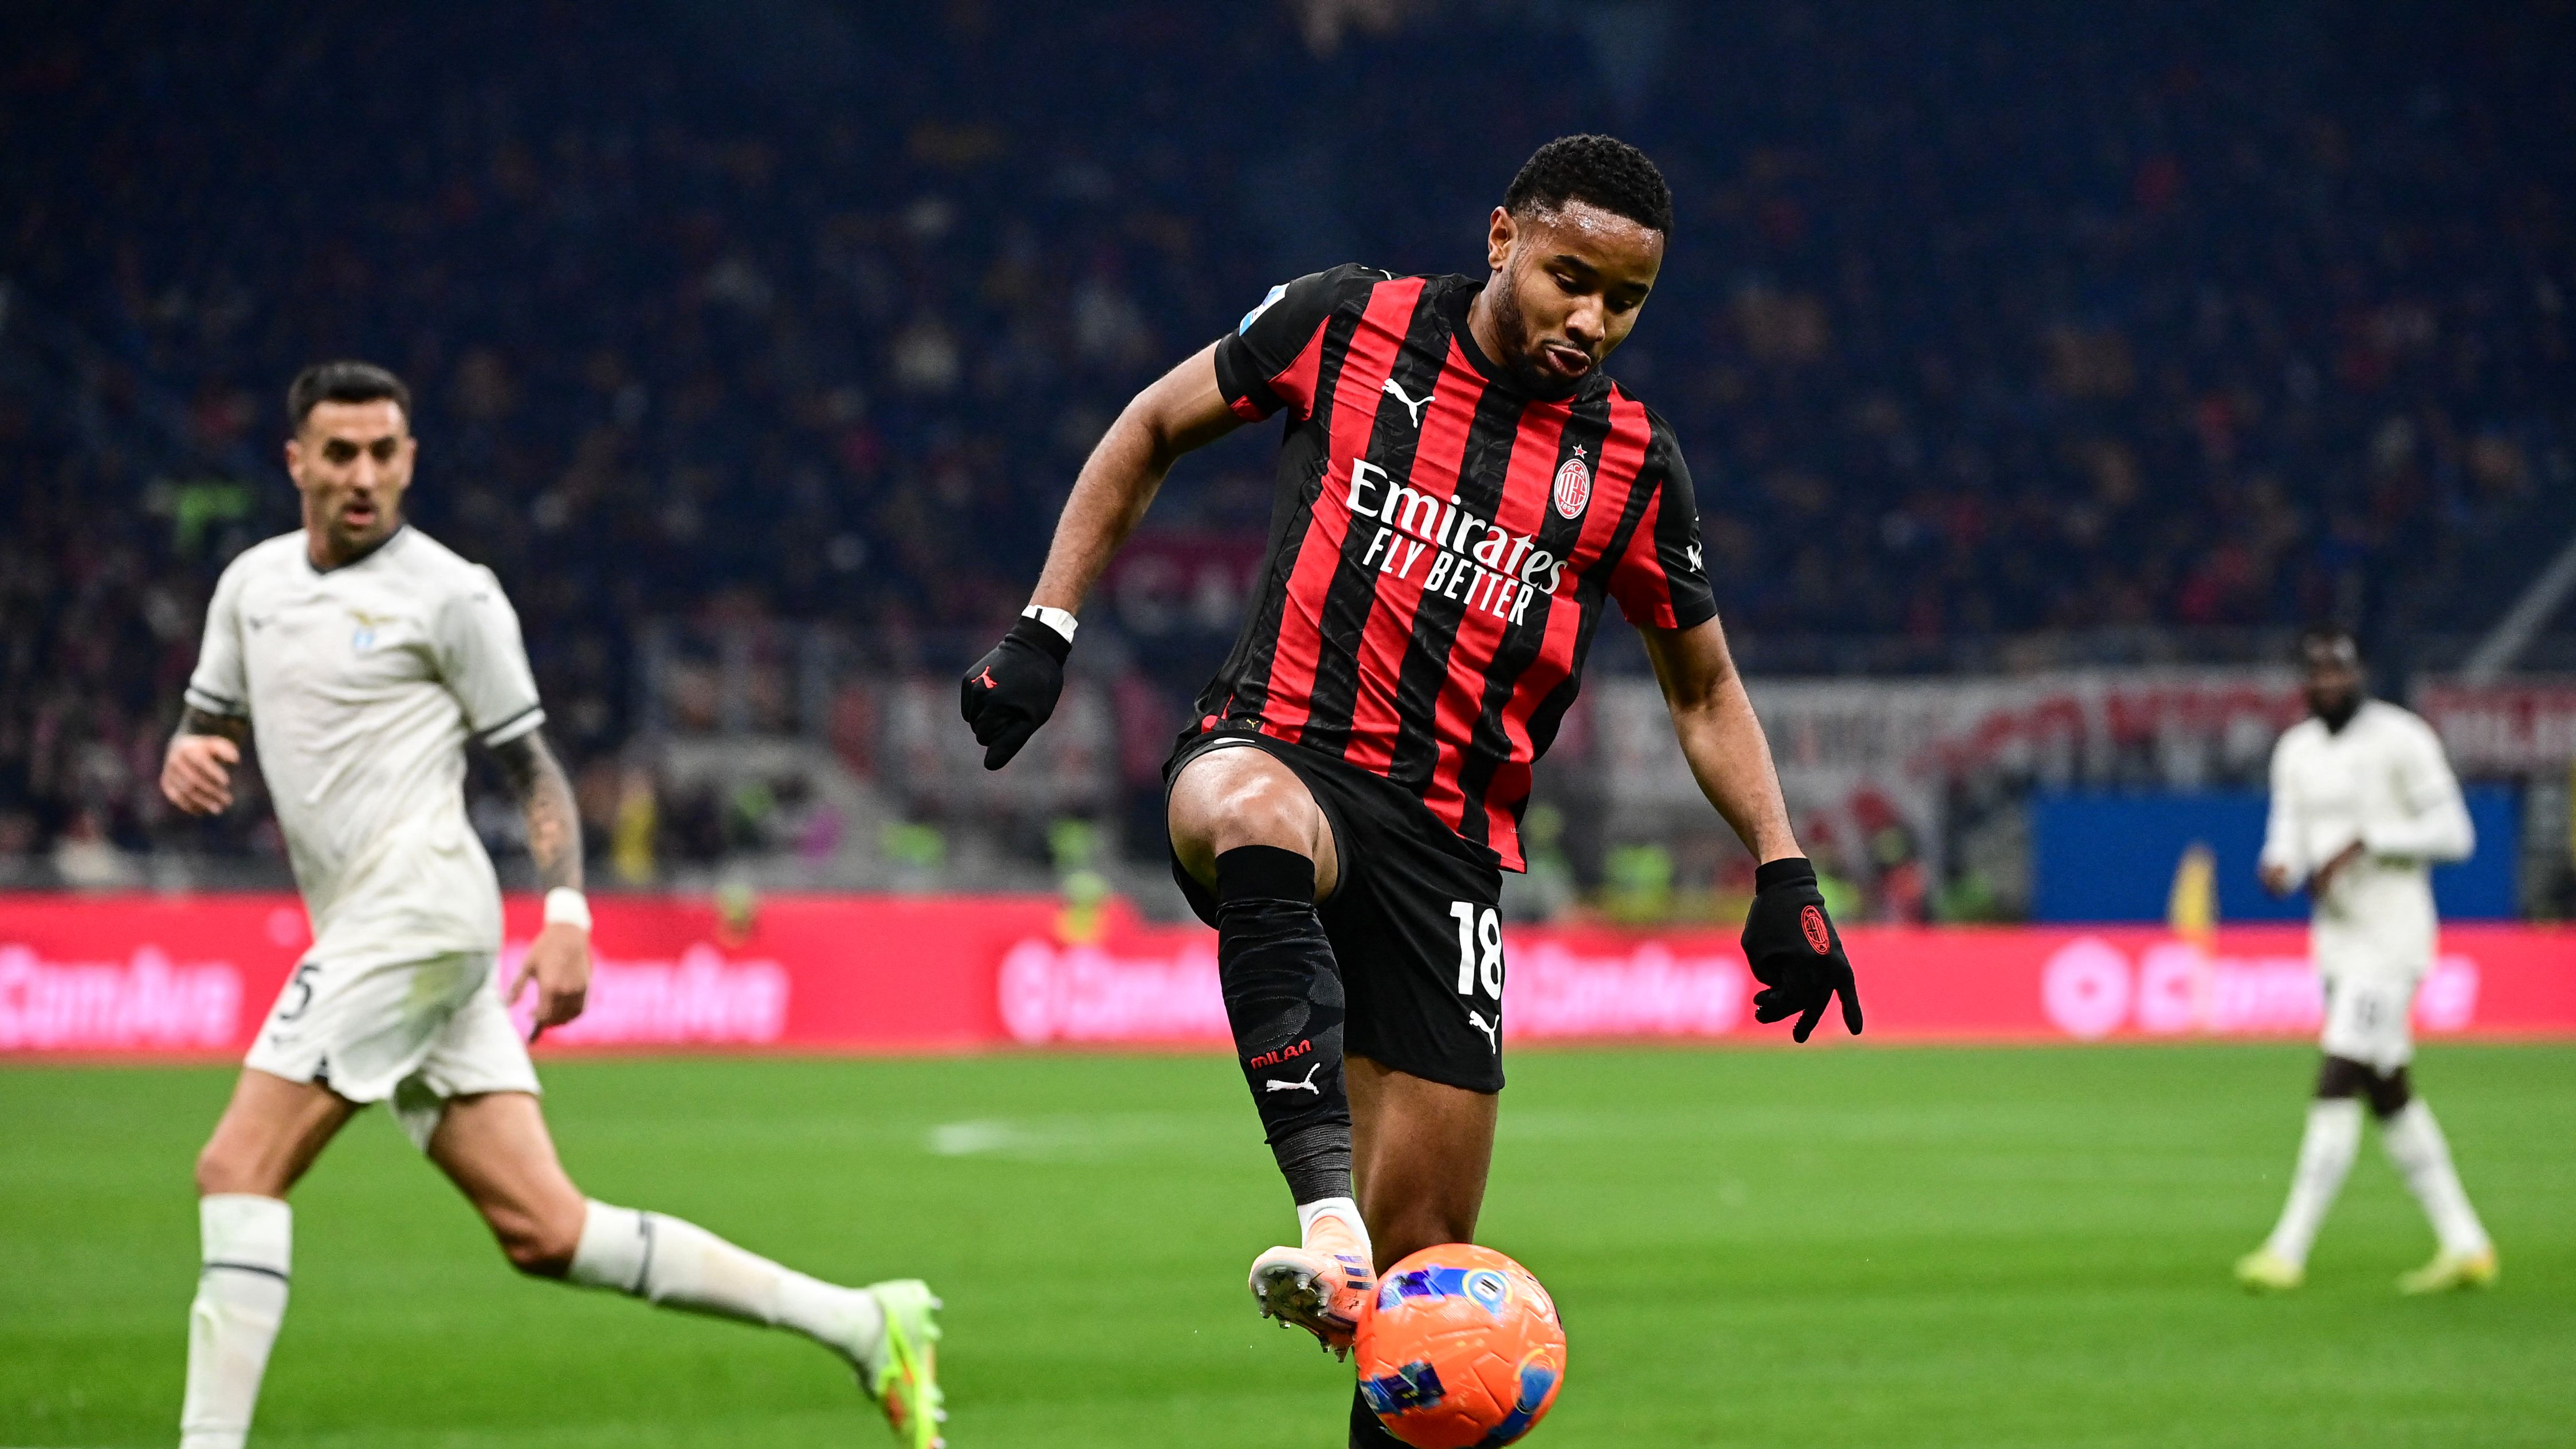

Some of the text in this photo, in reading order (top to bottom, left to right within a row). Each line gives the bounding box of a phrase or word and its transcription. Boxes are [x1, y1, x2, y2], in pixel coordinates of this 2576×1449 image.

[1560, 501, 1576, 513] 1899
[1566, 464, 1585, 480] ACM
[1345, 457, 1568, 595] Emirates
[1362, 526, 1534, 626] FLY BETTER
[1450, 901, 1502, 1000] 18
[280, 964, 320, 1019] 5
